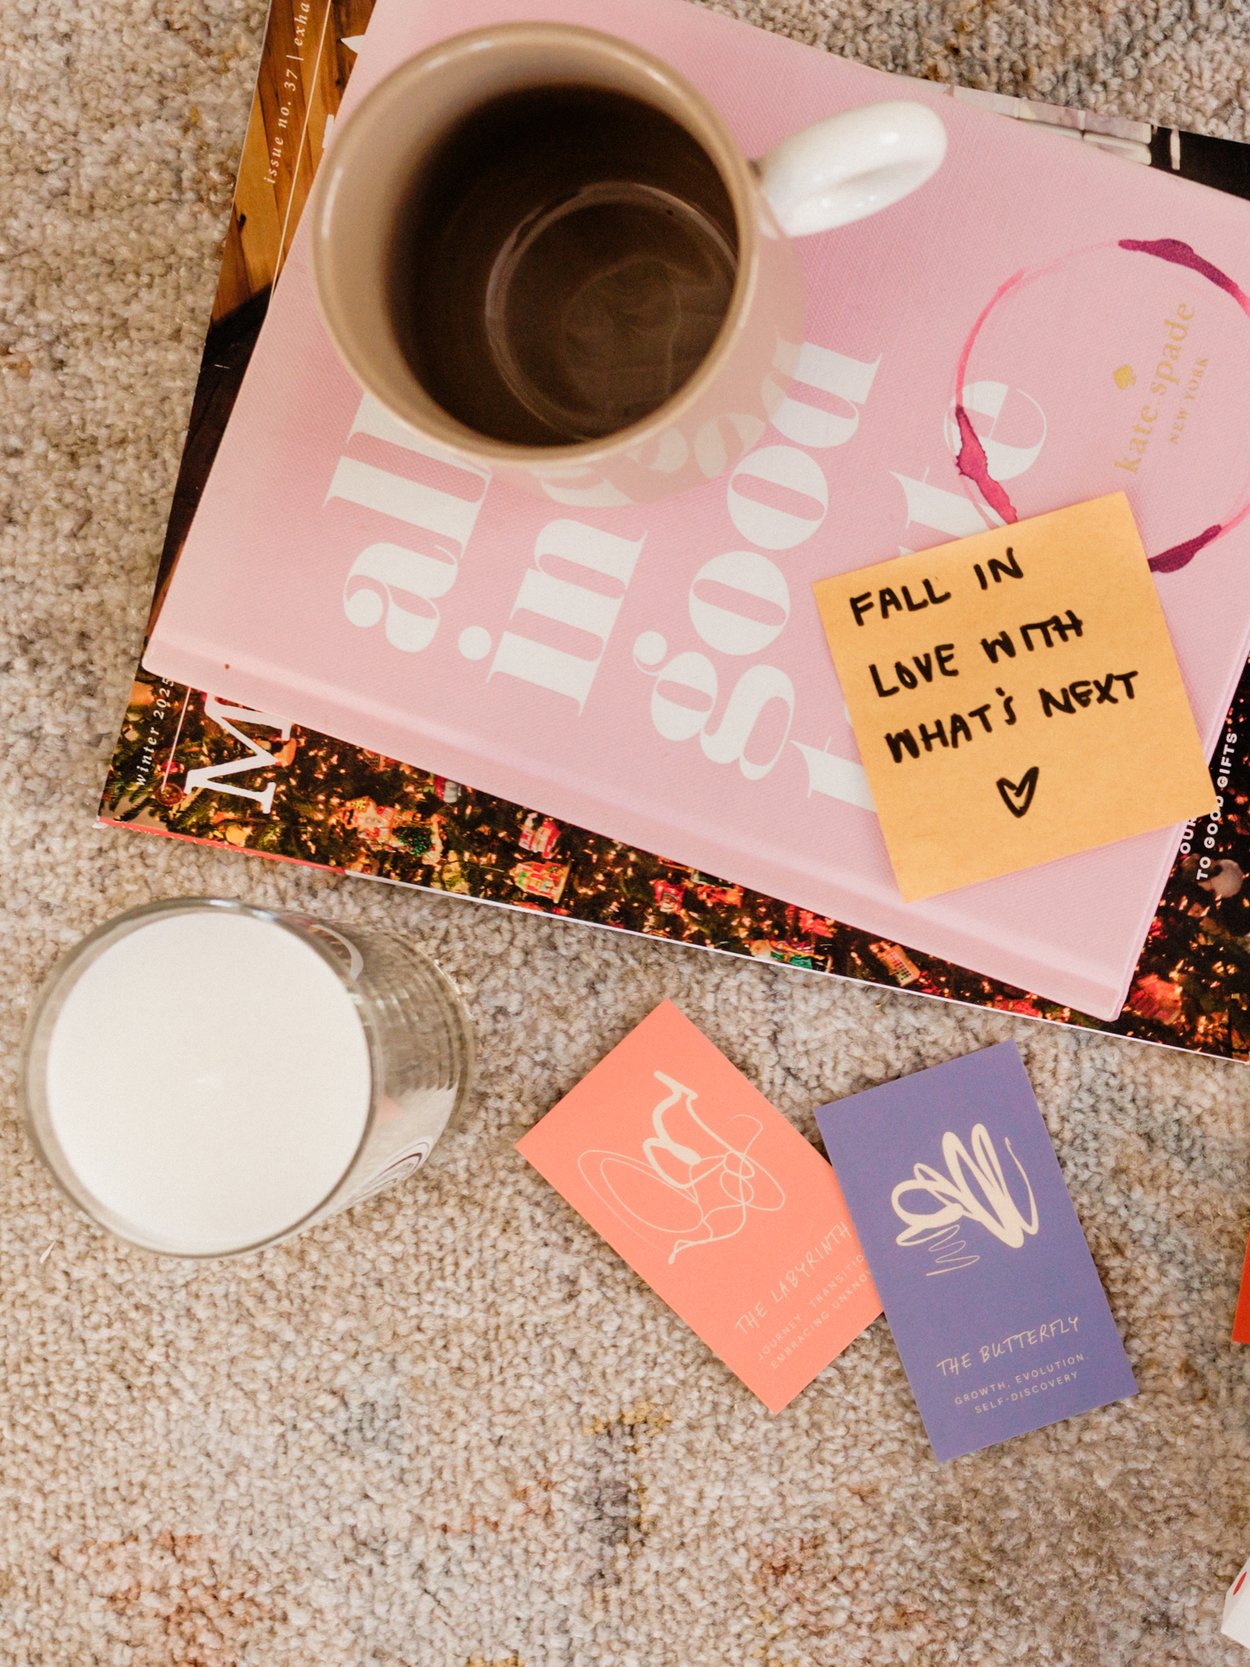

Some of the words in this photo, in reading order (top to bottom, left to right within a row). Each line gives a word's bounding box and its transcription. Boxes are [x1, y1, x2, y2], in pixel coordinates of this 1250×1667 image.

[277, 101, 292, 129] no.
[283, 69, 298, 92] 37
[264, 136, 284, 184] issue
[1113, 405, 1158, 474] kate
[1151, 303, 1195, 396] spade
[1168, 407, 1190, 445] NEW
[1184, 357, 1209, 400] YORK
[633, 341, 883, 781] good
[850, 579, 951, 626] FALL
[973, 547, 1024, 590] IN
[457, 518, 649, 719] in
[869, 643, 959, 697] LOVE
[981, 610, 1083, 664] WITH
[135, 728, 160, 787] winter
[153, 676, 175, 721] 2025
[884, 687, 1017, 763] WHAT'S
[1038, 671, 1138, 717] NEXT
[1197, 856, 1211, 881] TO
[1204, 795, 1224, 849] GOOD
[1217, 733, 1238, 788] GIFTS
[734, 1301, 768, 1335] THE
[770, 1221, 852, 1304] LABYRINTH
[771, 1311, 831, 1369] EMBRACING
[832, 1270, 872, 1309] UNKNO
[809, 1254, 864, 1308] TRANSITIO
[936, 1352, 972, 1376] THE
[979, 1316, 1079, 1363] BUTTERFLY
[975, 1371, 1078, 1414] SELF-DISCOVERY
